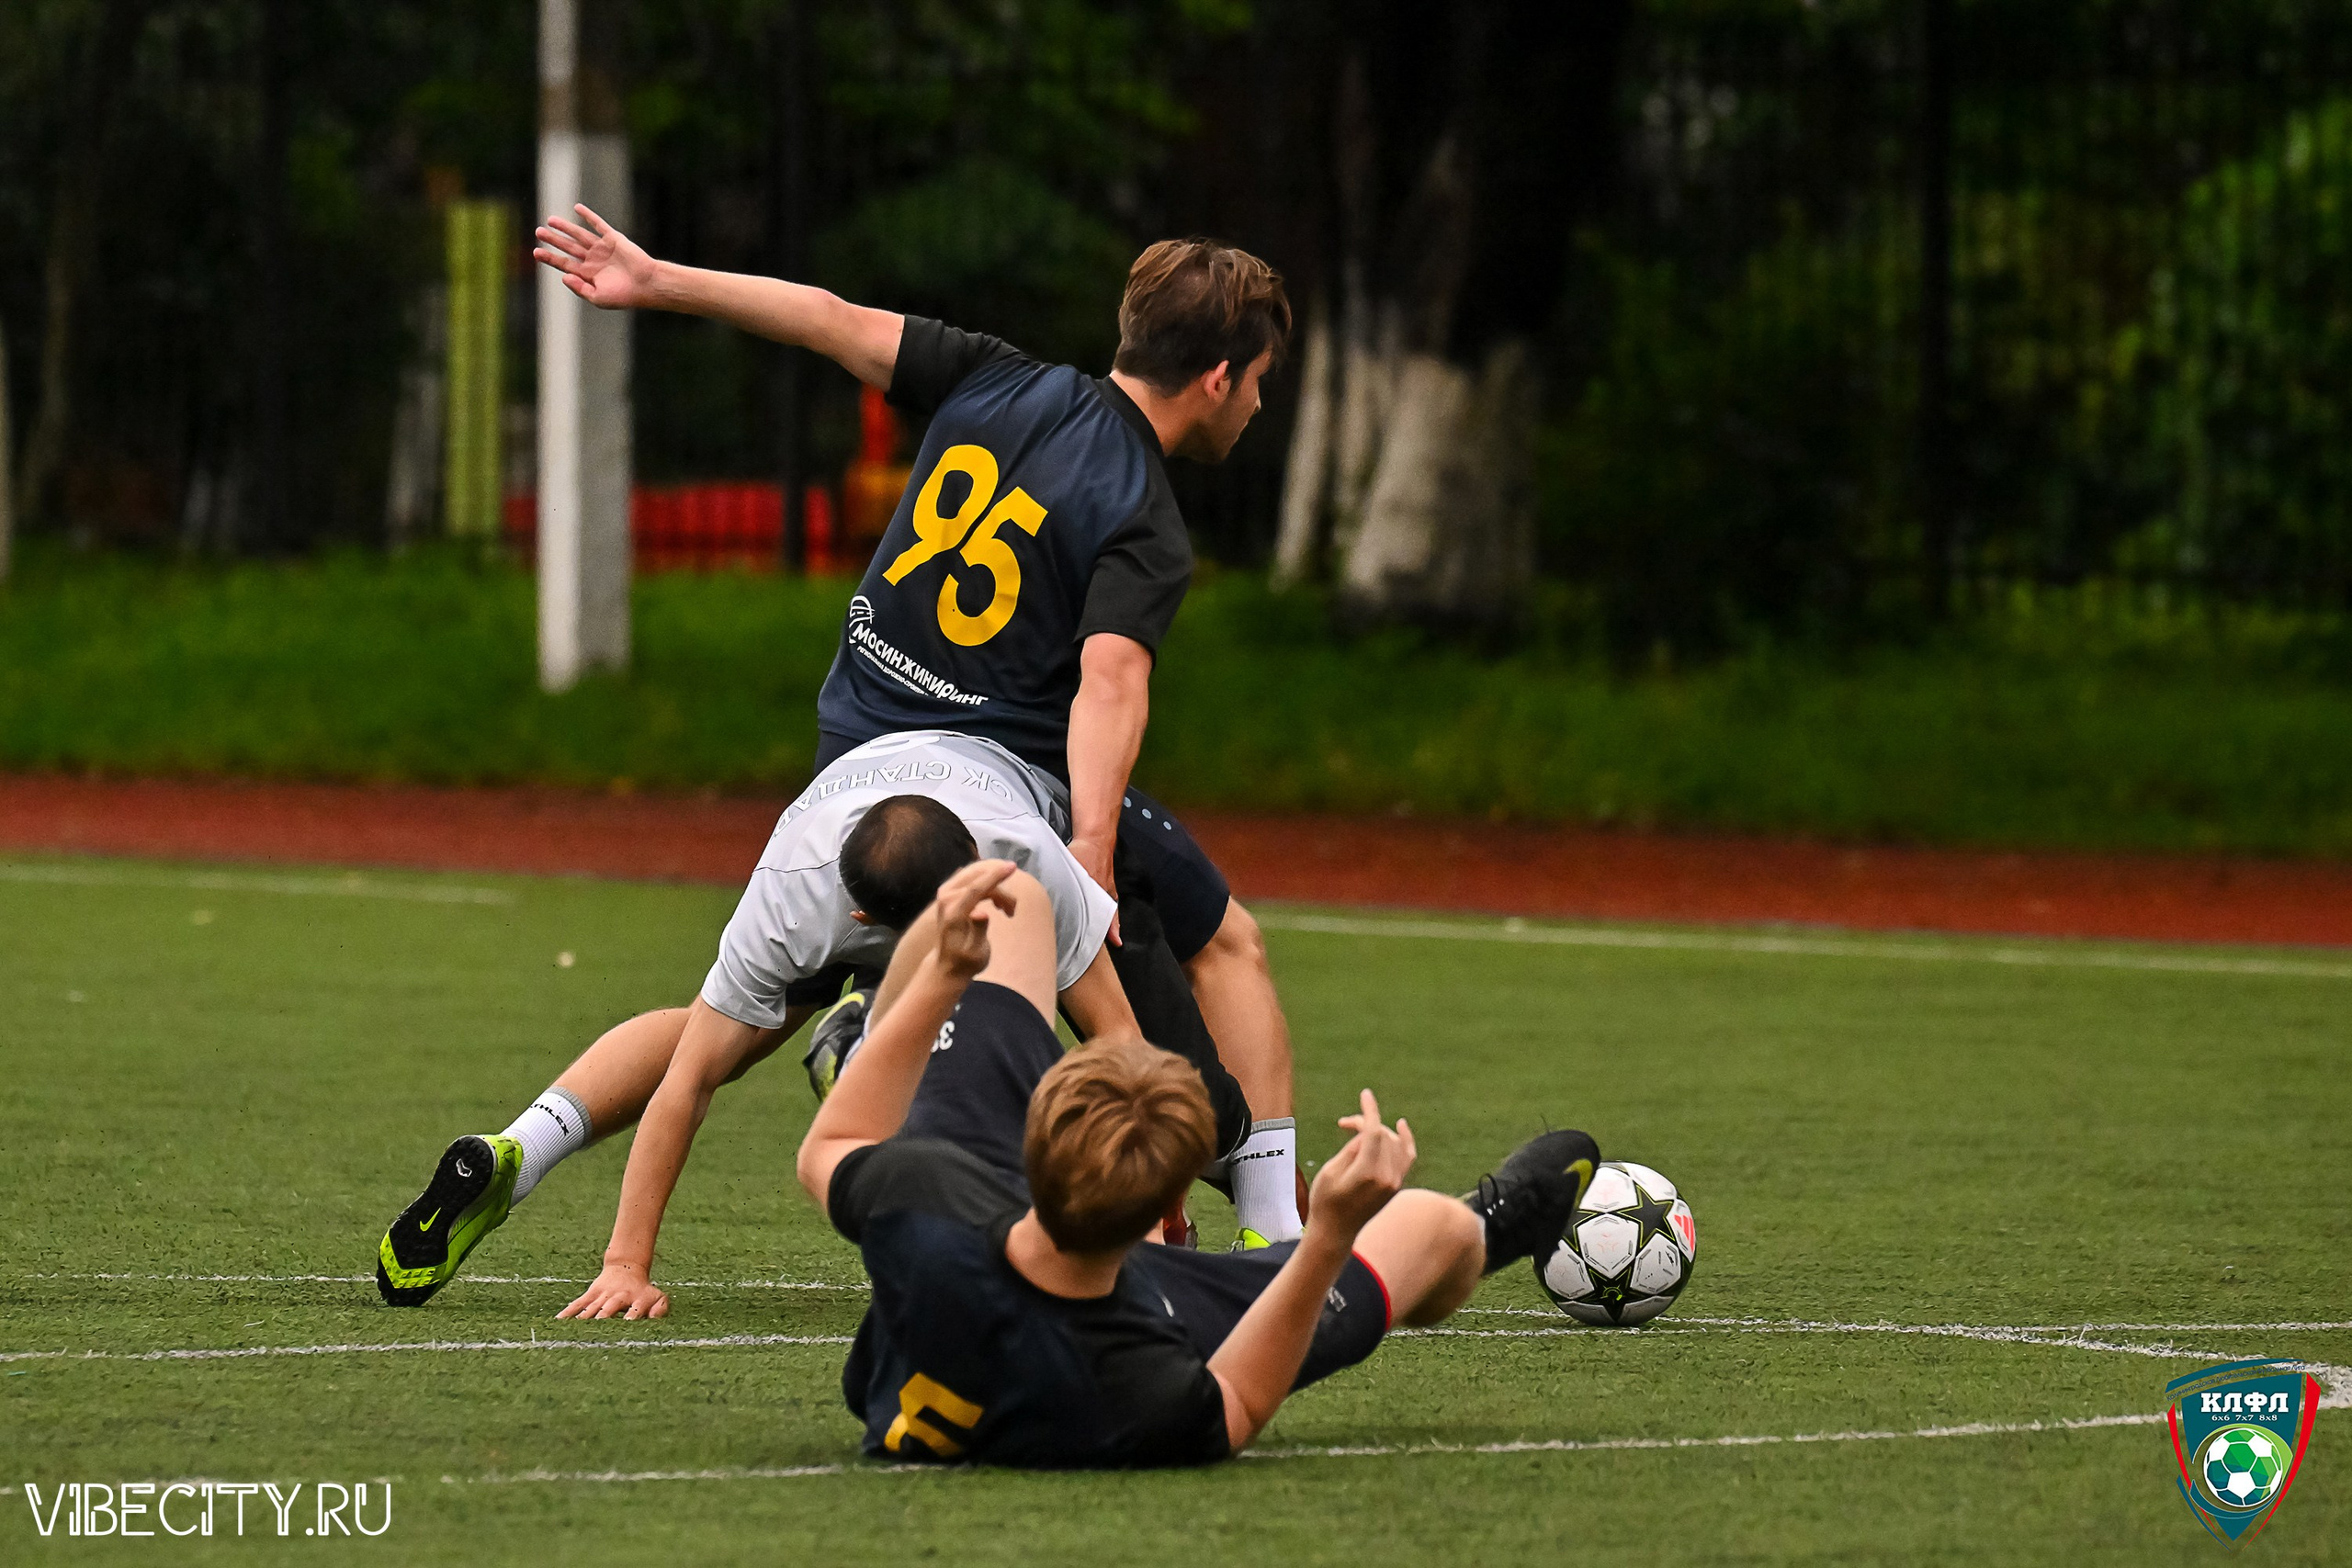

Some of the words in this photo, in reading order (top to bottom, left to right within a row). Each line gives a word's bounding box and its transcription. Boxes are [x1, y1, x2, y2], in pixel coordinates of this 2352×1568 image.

[881, 444, 1048, 648] 95
[852, 622, 989, 706] МОСИНЖИНИРИНГ
[773, 760, 952, 839] СТАНДАР
[961, 766, 1013, 803] СК
[530, 1103, 570, 1137] THLEX
